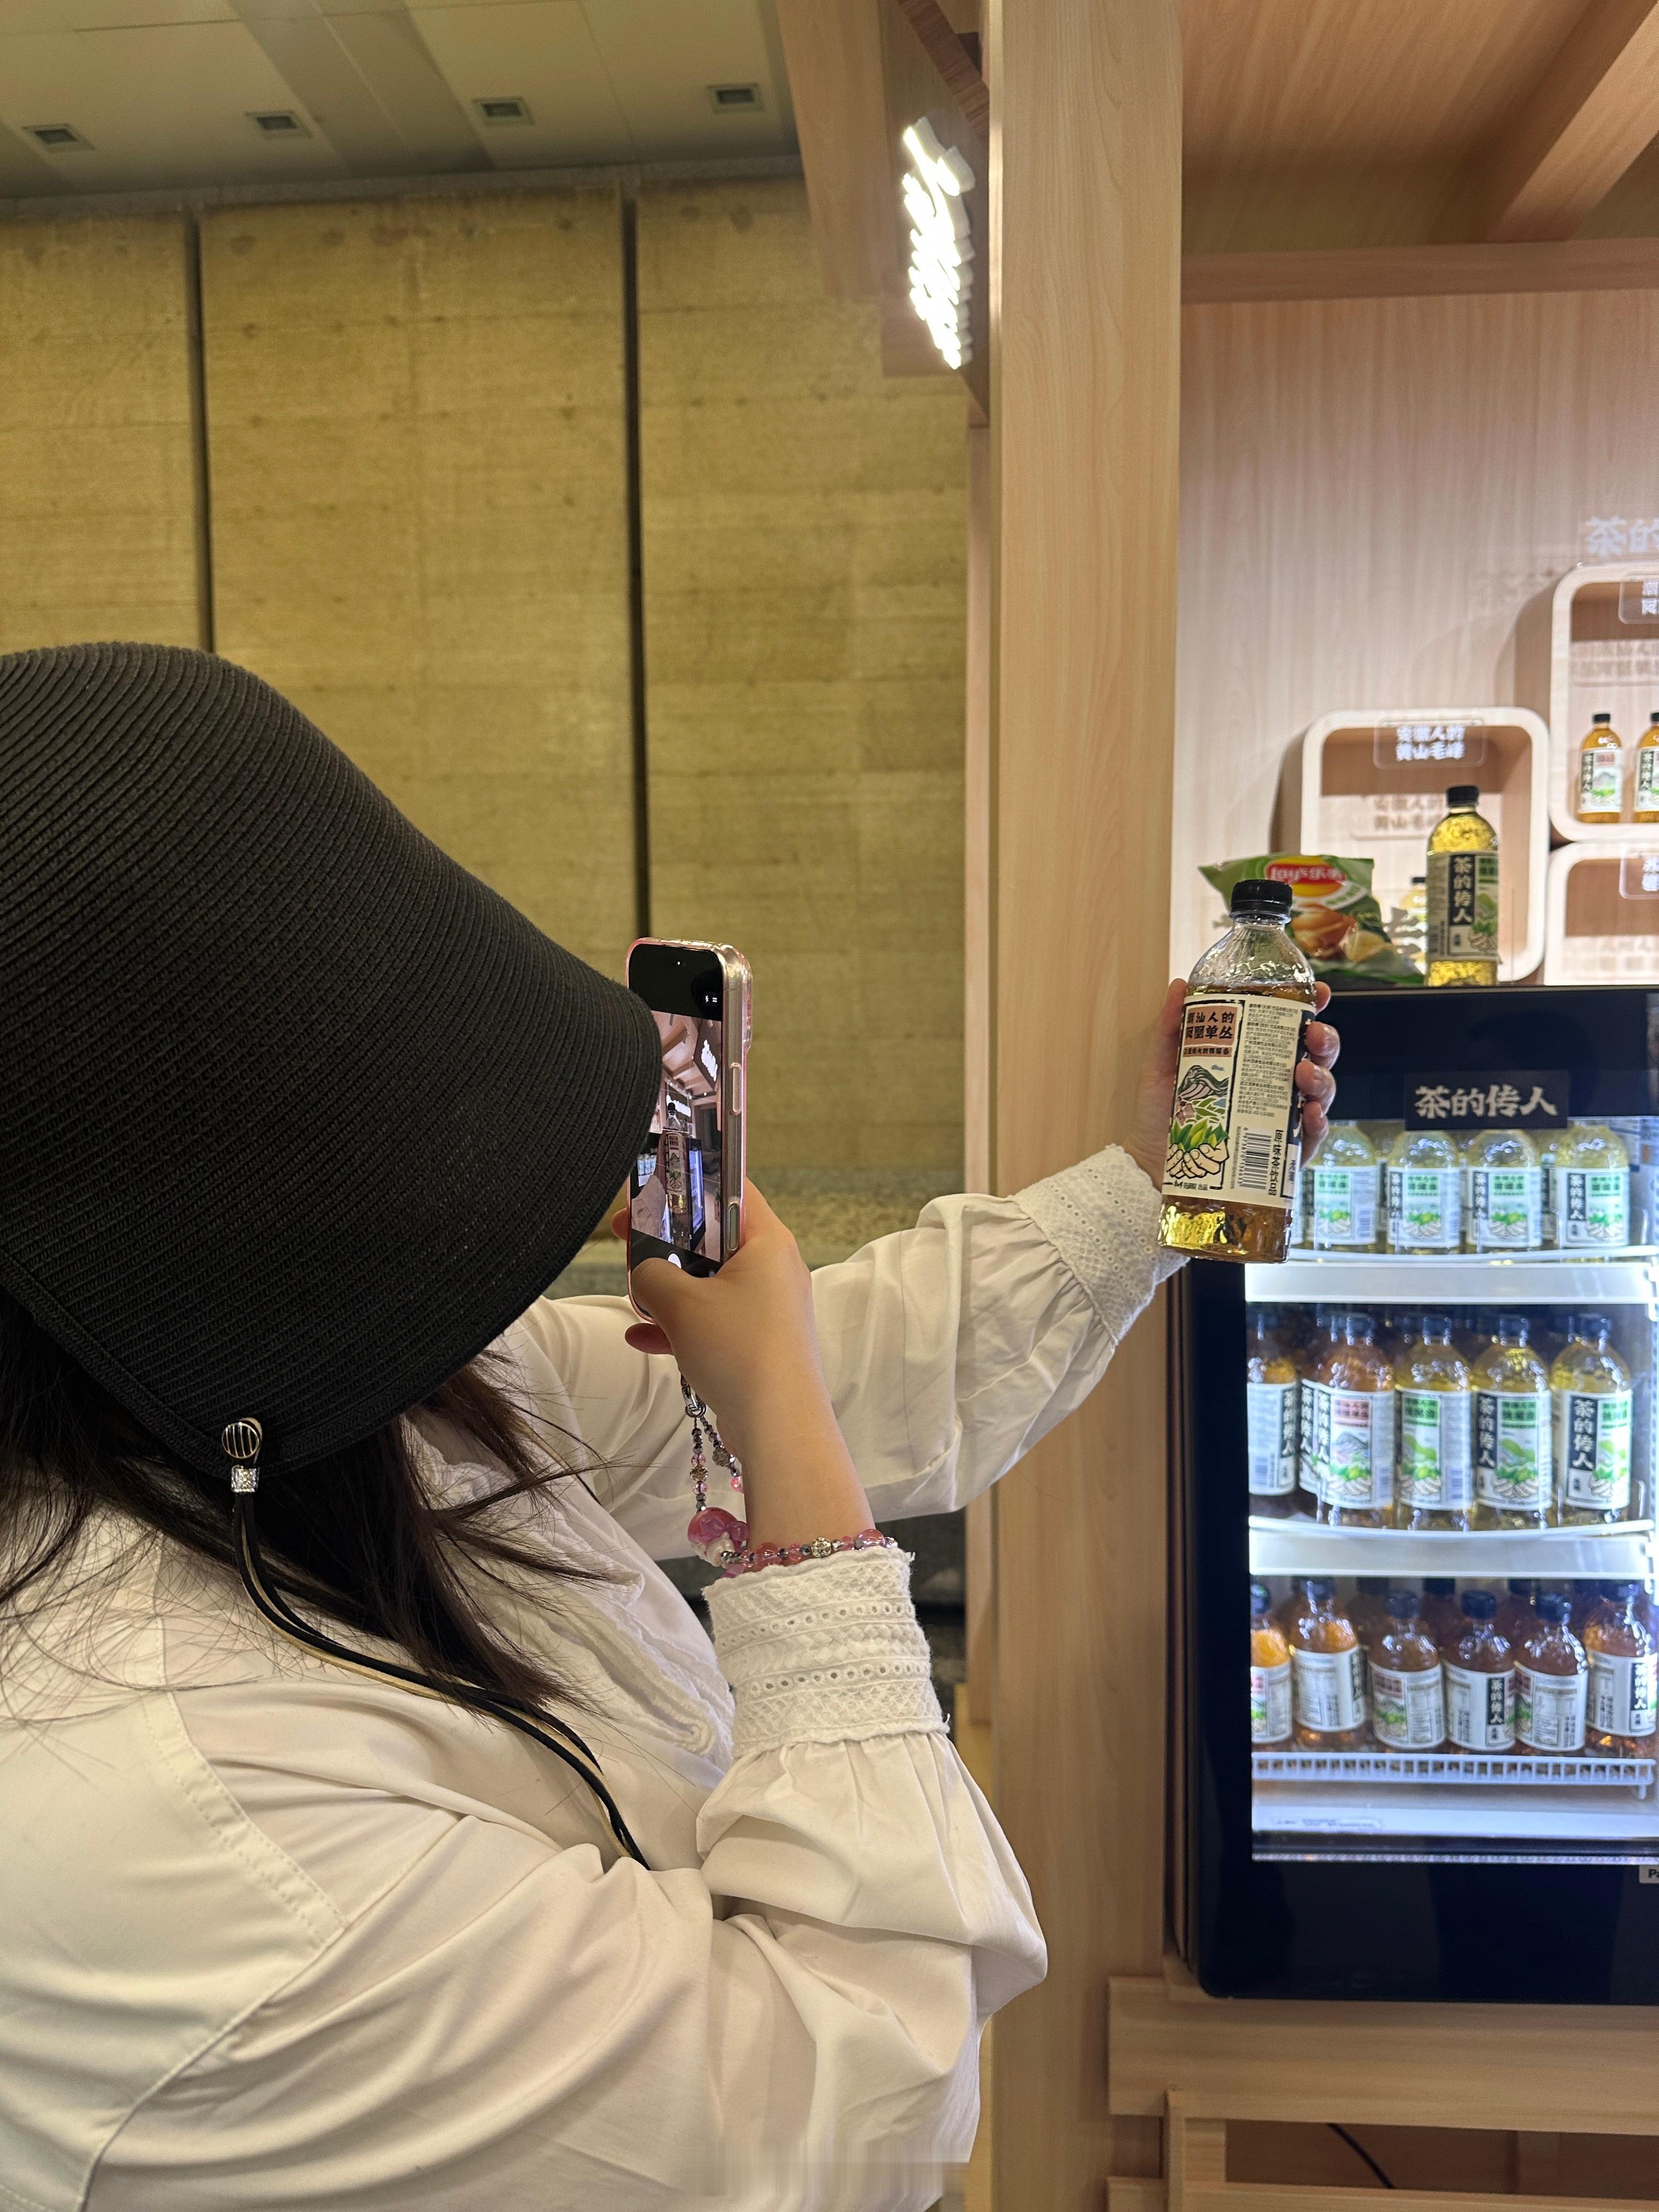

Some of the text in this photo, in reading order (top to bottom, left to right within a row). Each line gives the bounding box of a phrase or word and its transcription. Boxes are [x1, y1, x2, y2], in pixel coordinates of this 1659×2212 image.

[1453, 855, 1474, 924] 茶的传人
[1414, 1084, 1558, 1119] 茶的传人
[1480, 1396, 1496, 1468] 茶的传人
[1572, 1398, 1595, 1470] 茶的传人
